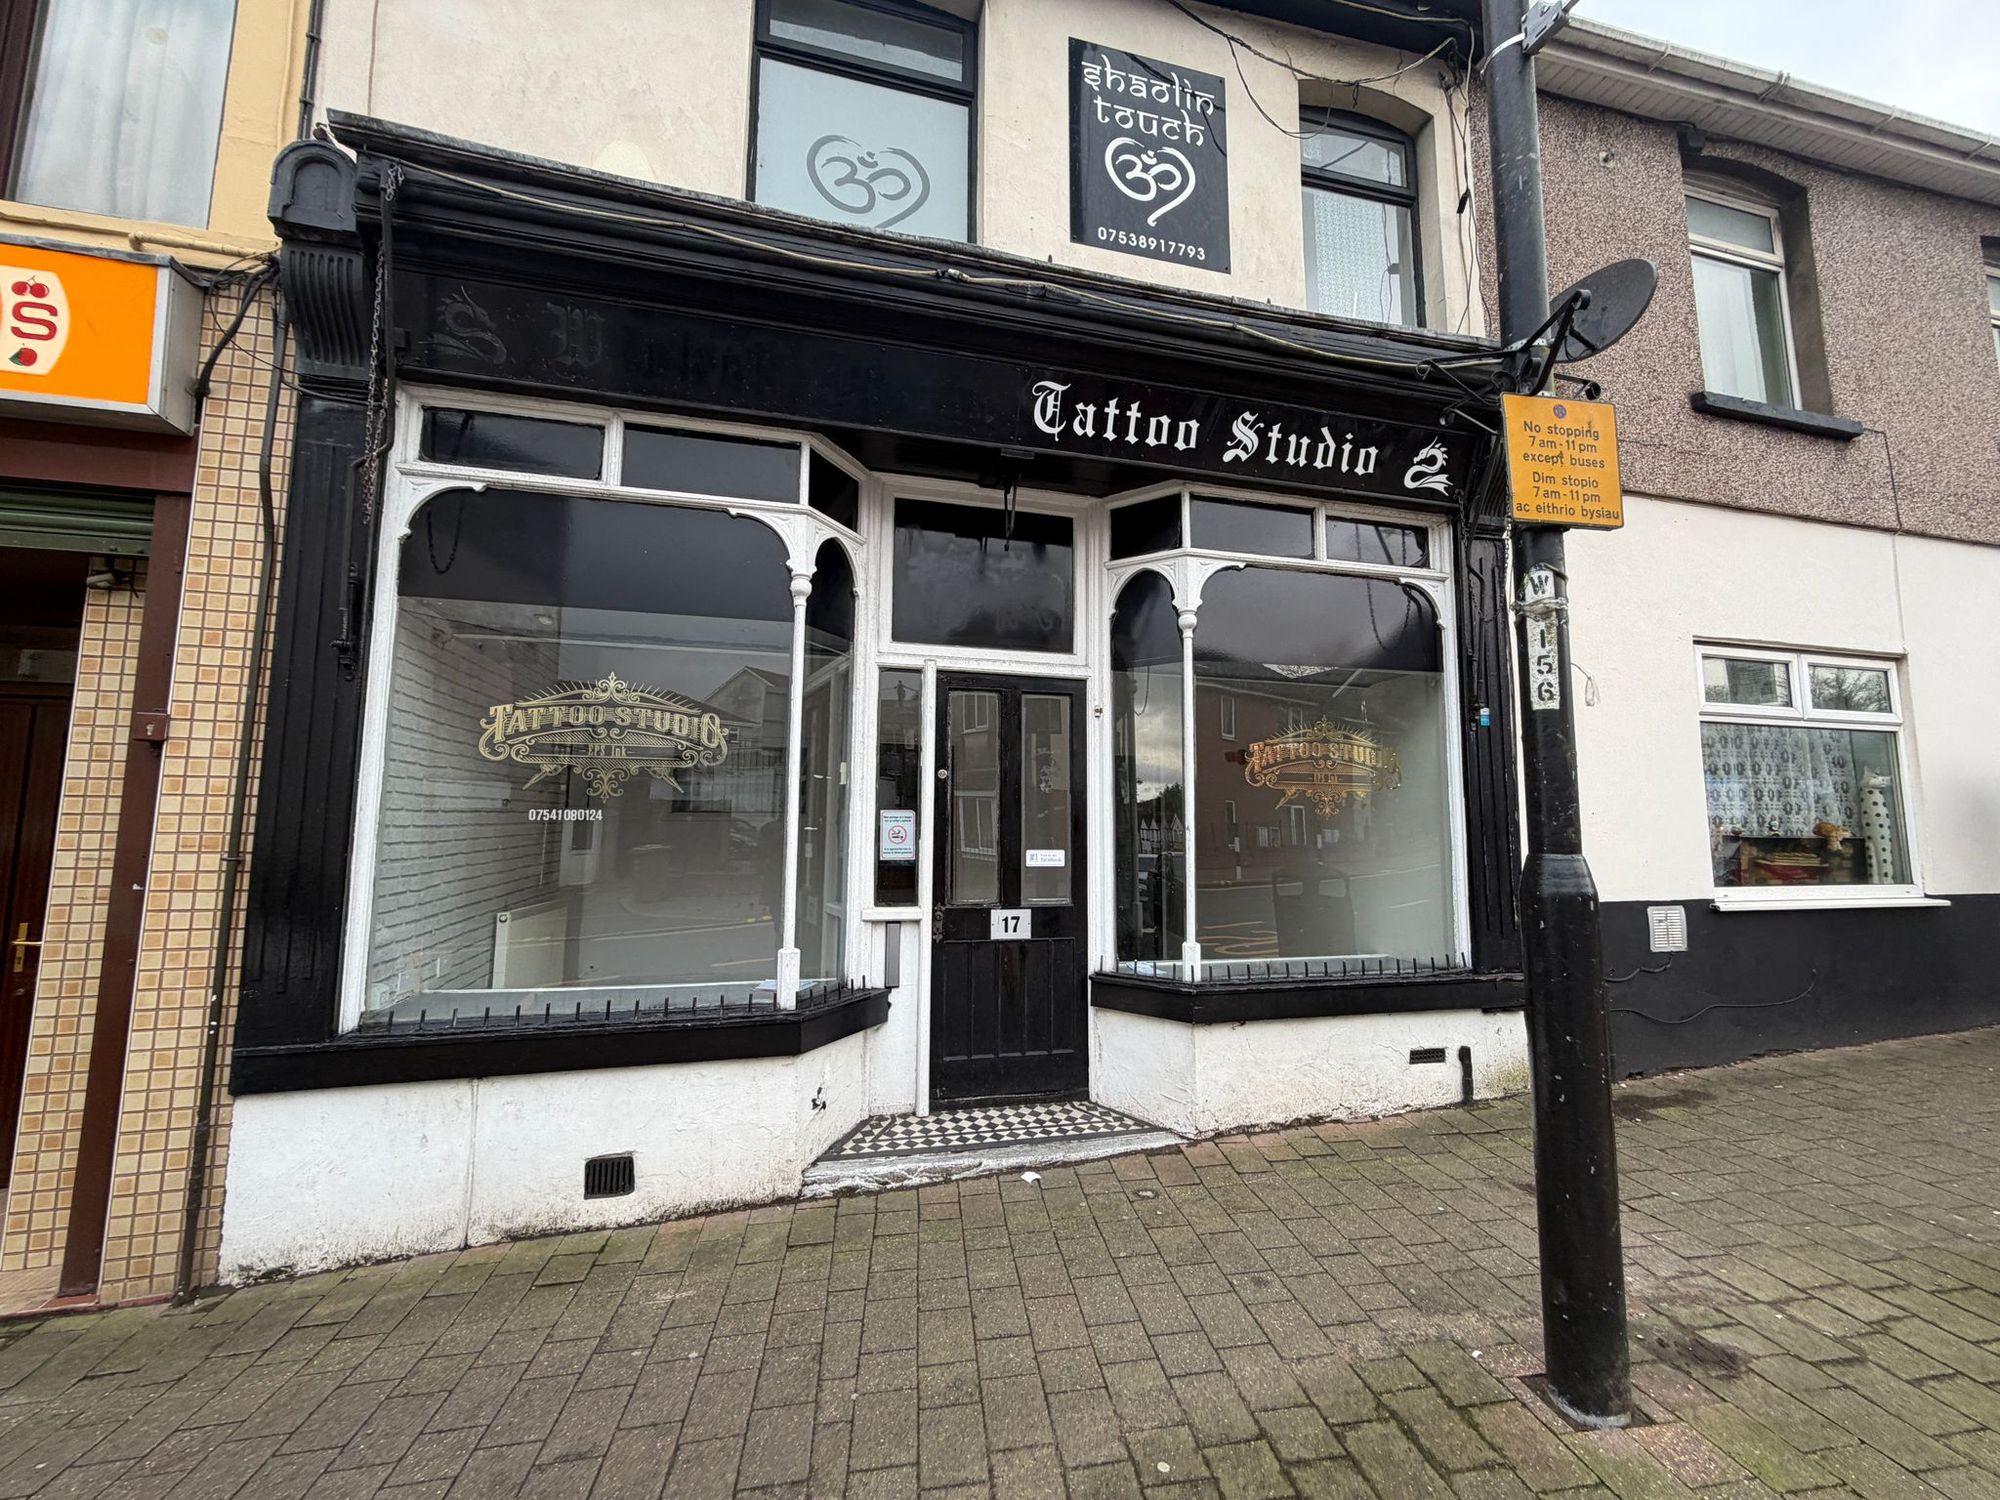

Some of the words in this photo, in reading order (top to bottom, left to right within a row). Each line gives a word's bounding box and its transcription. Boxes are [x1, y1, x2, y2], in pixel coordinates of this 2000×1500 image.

[1081, 54, 1215, 116] shaolin
[1094, 94, 1205, 147] touch
[1097, 226, 1206, 261] 07538917793
[1031, 380, 1200, 452] Tattoo
[1222, 410, 1380, 477] Studio
[1523, 421, 1541, 433] No
[1547, 424, 1600, 440] stopping
[1523, 452, 1564, 466] except
[1570, 455, 1605, 468] buses
[1532, 472, 1556, 484] Dim
[1562, 475, 1599, 489] stopio
[1516, 502, 1530, 513] ac
[1536, 502, 1576, 516] eithrio
[1581, 506, 1620, 520] bysiau
[480, 703, 606, 748] TATTOO
[614, 706, 723, 748] STUDIO
[528, 809, 603, 821] 07541080124
[1001, 915, 1021, 933] 17
